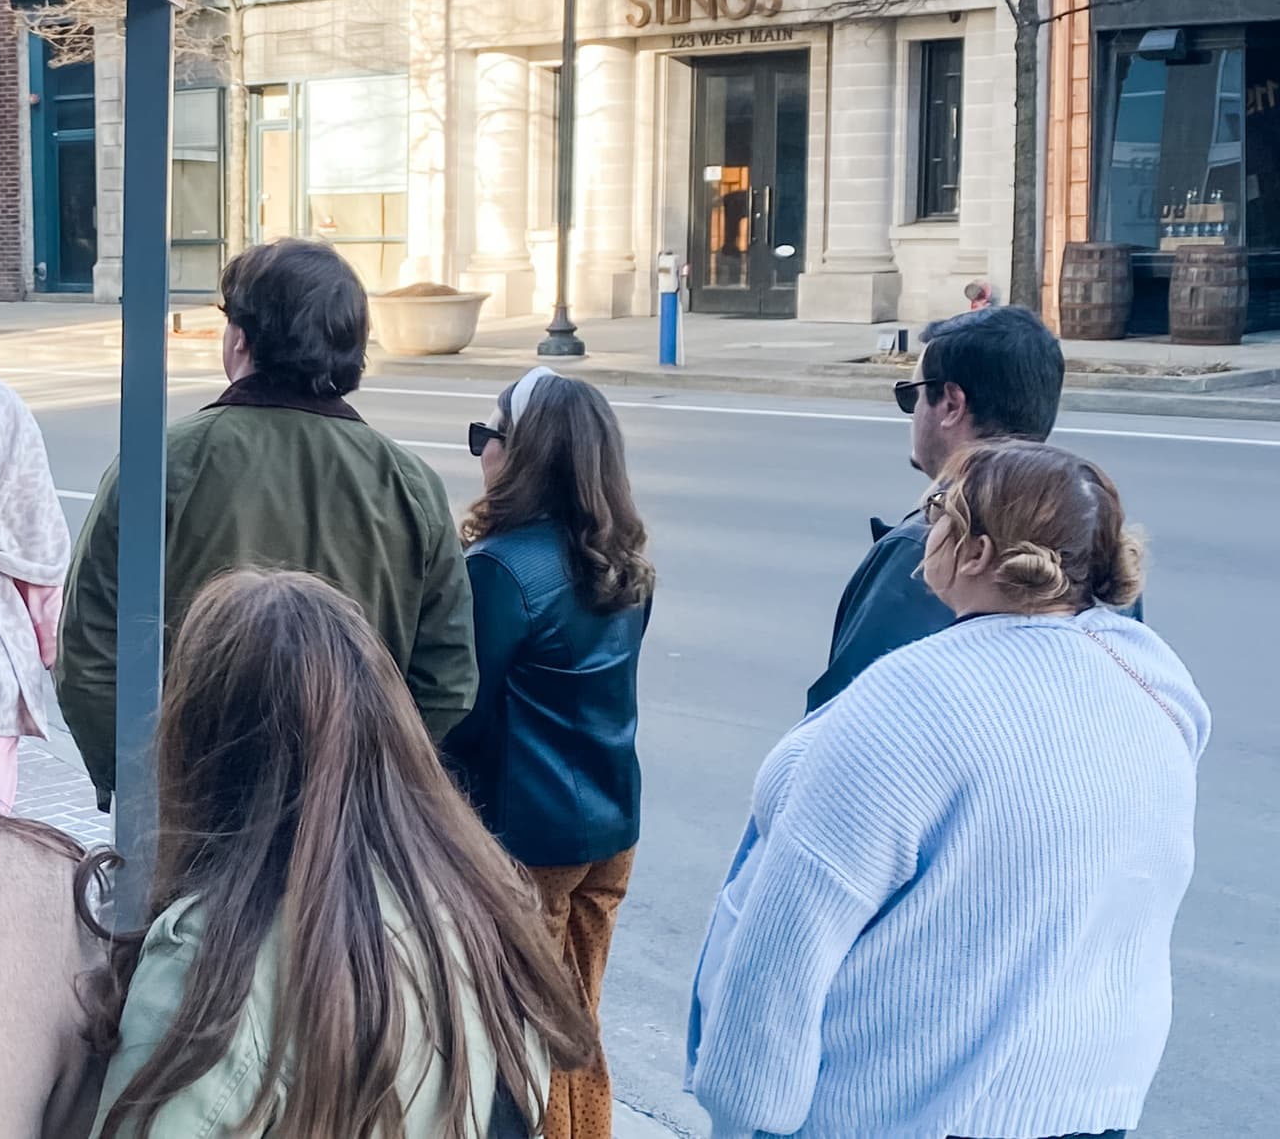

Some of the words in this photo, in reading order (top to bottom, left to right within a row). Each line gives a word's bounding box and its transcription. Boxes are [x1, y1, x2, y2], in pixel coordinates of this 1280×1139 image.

[671, 34, 696, 49] 123
[700, 30, 745, 47] WEST
[750, 26, 793, 44] MAIN
